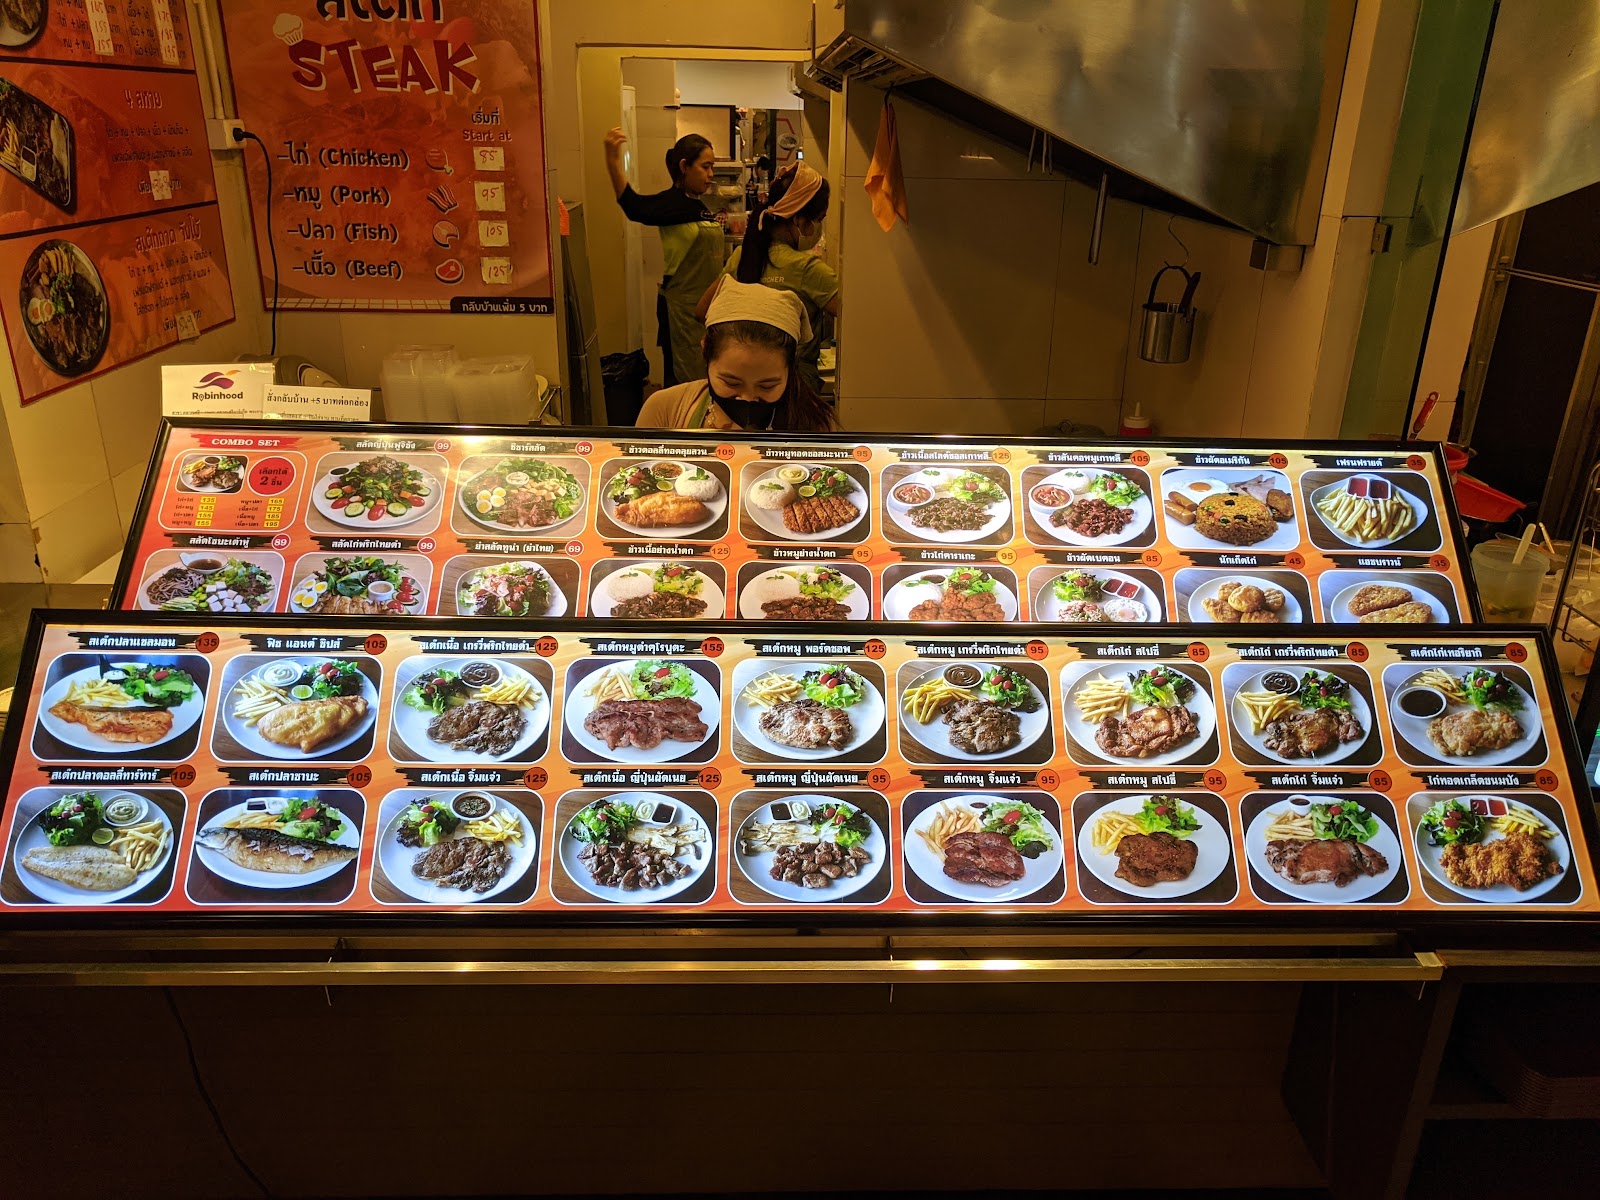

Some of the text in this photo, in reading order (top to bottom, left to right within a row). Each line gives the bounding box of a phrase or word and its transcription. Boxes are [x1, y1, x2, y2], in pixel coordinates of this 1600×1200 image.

[288, 37, 481, 95] STEAK
[472, 106, 500, 125] เริ่มที่
[462, 130, 512, 142] Start at
[320, 148, 410, 170] (Chicken)
[479, 150, 498, 164] 85
[330, 186, 392, 206] (Pork)
[481, 188, 499, 201] 95
[344, 222, 398, 244] (Fish)
[486, 226, 504, 237] 105
[345, 258, 404, 280] (Beef)
[462, 299, 548, 312] กลับบ้านเพิ่ม 5 บาท
[192, 392, 244, 402] Robinhood
[212, 438, 254, 446] COMBO
[436, 442, 450, 450] 99
[578, 445, 590, 453] 99
[716, 448, 734, 456] 105
[856, 450, 868, 458] 95
[1048, 451, 1122, 463] ข้าวสันคอหมูเกาหลี
[1195, 454, 1250, 466] ข้าวผัดอเมริกัน
[260, 476, 268, 486] 2
[274, 538, 288, 546] 89
[331, 538, 434, 550] สลัดไก่พริกไทยดำ 99
[475, 542, 581, 554] ยำสลัดทูน่า (ยำไทย) 69
[628, 544, 729, 556] ข้าวเนื้อย่างน้ำตก 125
[773, 548, 869, 560] ข้าวหมูย่างน้ำตก 95
[920, 550, 1013, 561] ข้าวไก่คาราเกะ 95
[1066, 553, 1120, 563] ข้าวผัดเบคอน
[1219, 555, 1257, 565] นักเก็ตไก่
[1358, 557, 1402, 566] แฮชบราวน์
[196, 637, 218, 647] 135
[267, 637, 282, 648] ฟิช
[286, 638, 316, 648] แอนด์
[365, 640, 385, 649] 105
[463, 638, 529, 651] เกรวี่พริกไทยดำ
[536, 641, 557, 651] 125
[703, 643, 723, 652] 155
[865, 644, 885, 653] 125
[957, 643, 1025, 656] เกรวี่พริกไทยดำ
[1031, 646, 1044, 654] 95
[1135, 643, 1160, 656] สไปซี่
[1191, 648, 1206, 656] 85
[1274, 645, 1339, 658] เกรวี่พริกไทยดำ
[1350, 648, 1365, 657] 85
[1510, 649, 1524, 657] 85
[172, 770, 194, 781] 105
[350, 772, 371, 782] 105
[467, 770, 501, 783] จิ้มแจ่ว
[525, 773, 547, 783] 125
[629, 770, 687, 786] ญี่ปุ่นผัดเนย
[699, 773, 719, 783] 125
[801, 771, 858, 786] ญี่ปุ่นผัดเนย
[872, 775, 886, 784] 95
[988, 772, 1021, 784] จิ้มแจ่ว
[1041, 775, 1055, 784] 95
[1151, 773, 1177, 786] สไปซี่
[1208, 776, 1222, 785] 95
[1311, 774, 1343, 786] จิ้มแจ่ว
[1374, 777, 1388, 786] 85
[1427, 774, 1553, 786] ไก่ทอดเกล็ดขนมปัง 85
